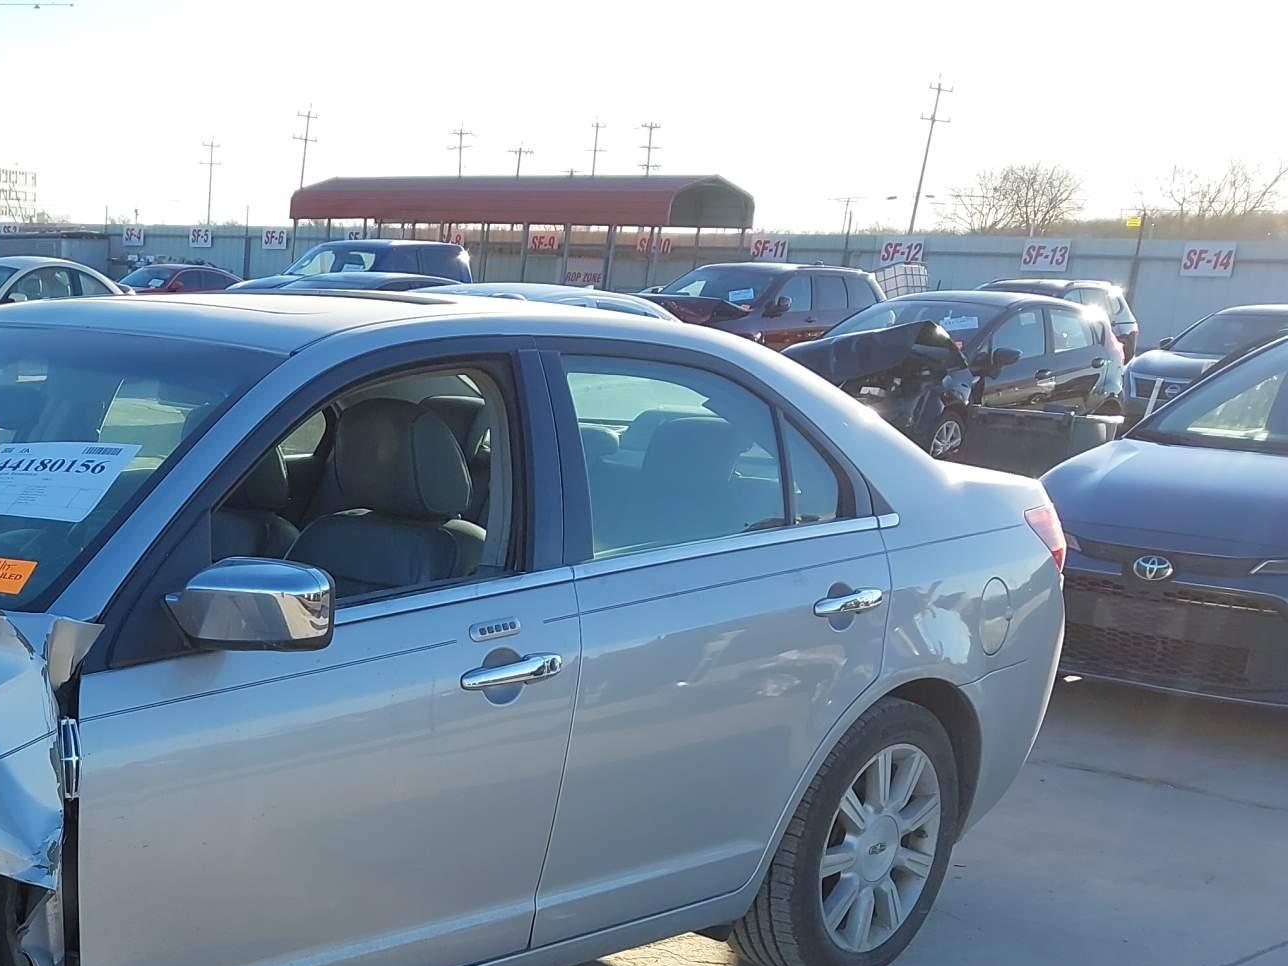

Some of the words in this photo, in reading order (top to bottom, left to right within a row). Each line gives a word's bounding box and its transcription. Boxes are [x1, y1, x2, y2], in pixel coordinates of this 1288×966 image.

[124, 228, 142, 242] SF-4
[191, 228, 209, 243] SF-5
[264, 230, 285, 245] SF-6
[531, 235, 555, 249] SF-9
[752, 239, 787, 258] SF-11
[881, 242, 923, 264] SF-12
[1022, 245, 1069, 266] SF-13
[1183, 249, 1234, 270] SF-14
